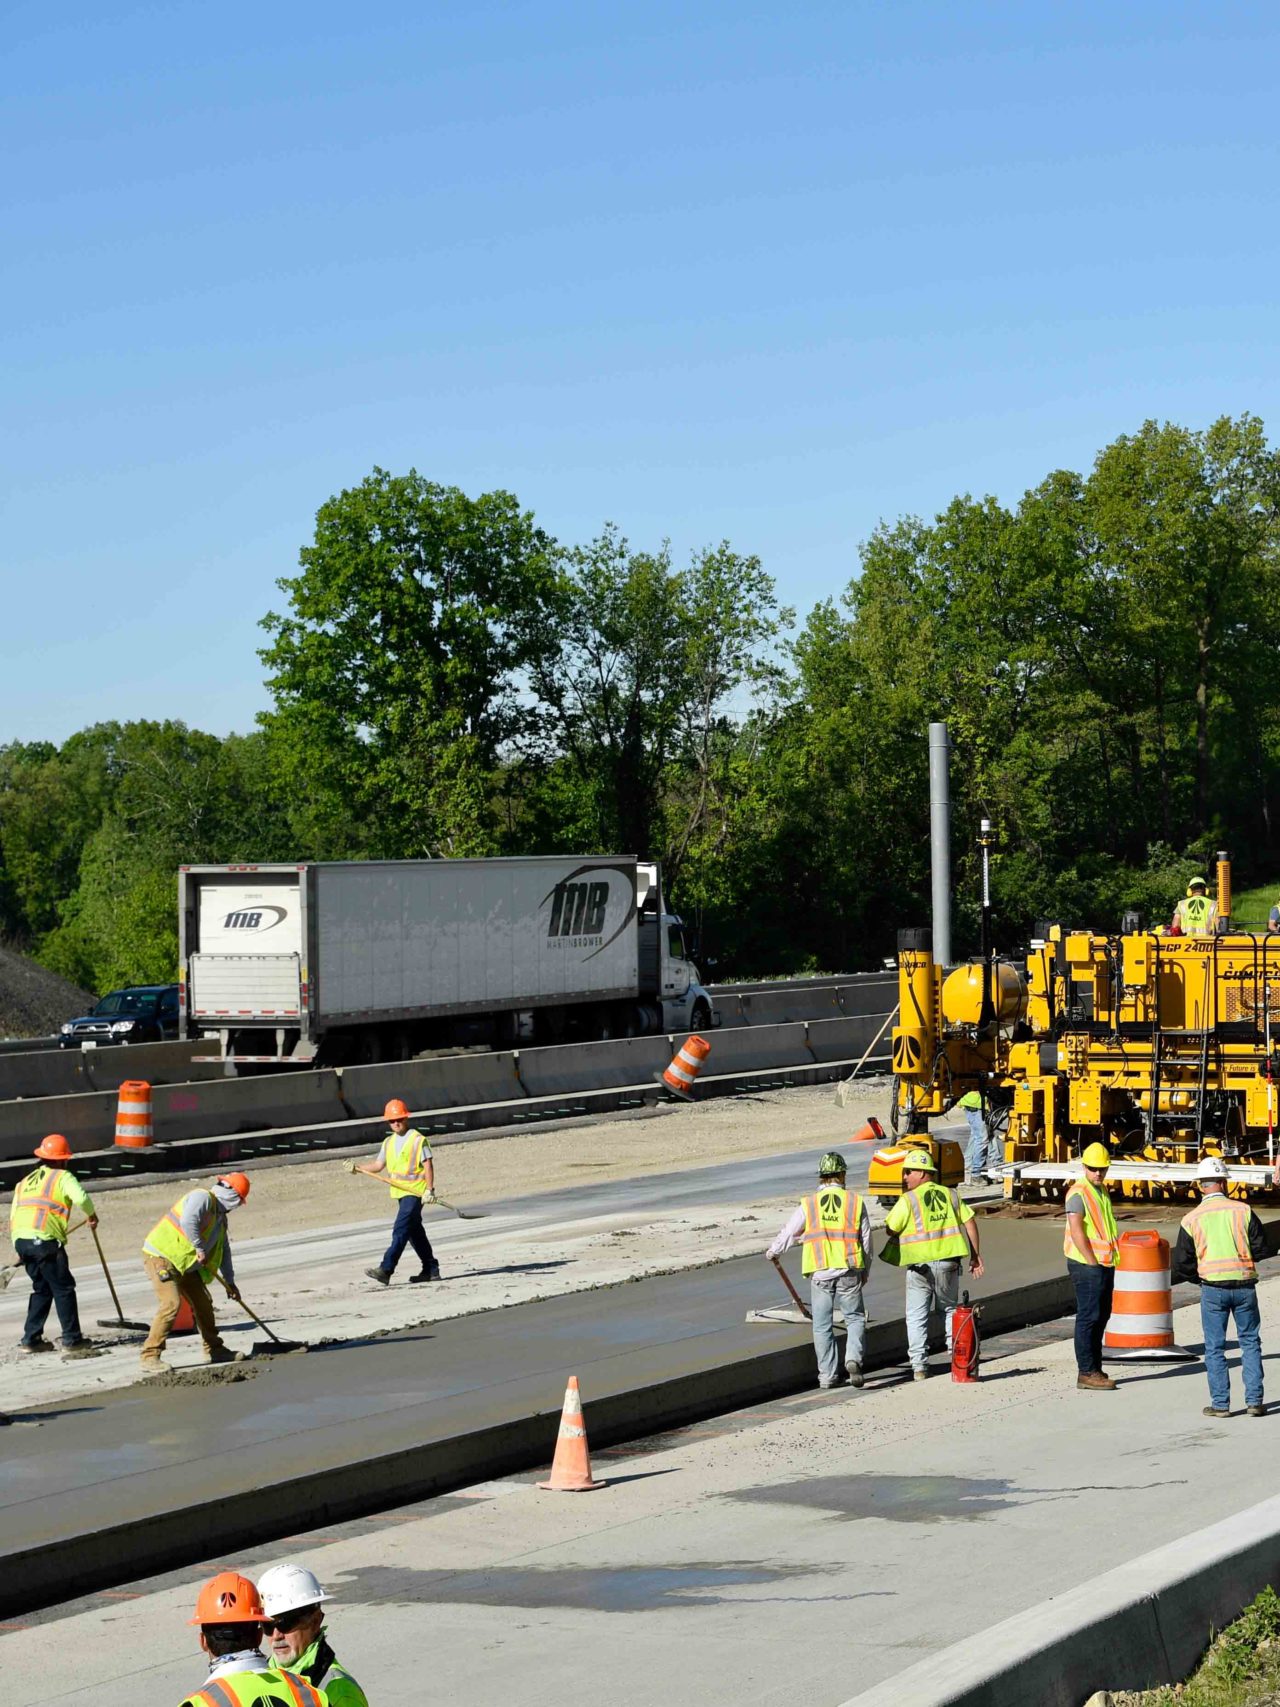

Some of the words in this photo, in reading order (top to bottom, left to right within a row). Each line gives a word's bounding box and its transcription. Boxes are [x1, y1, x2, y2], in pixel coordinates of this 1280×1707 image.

[548, 882, 609, 937] MB
[223, 912, 263, 928] MB
[1165, 943, 1182, 953] GP
[1184, 943, 1213, 953] 2400
[1228, 1063, 1249, 1072] Future
[1250, 1063, 1256, 1072] is
[821, 1214, 839, 1222] AJAX
[930, 1213, 948, 1222] AJAX
